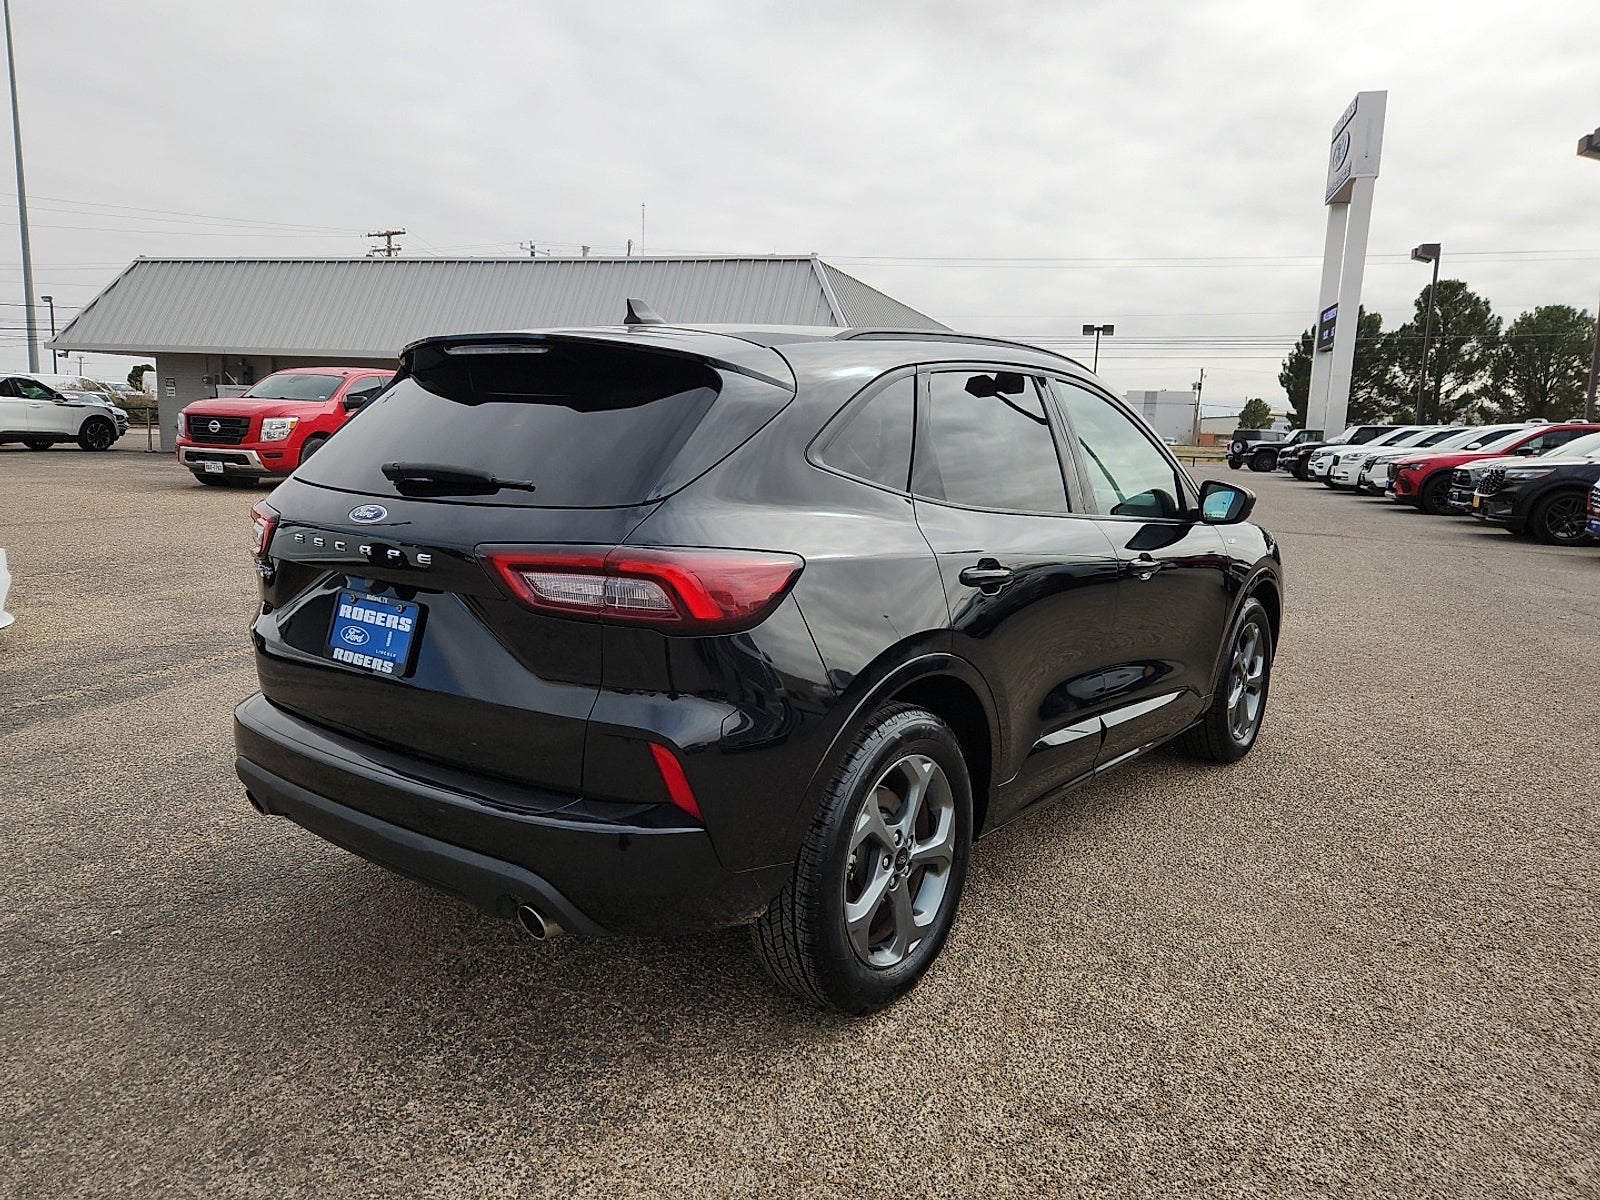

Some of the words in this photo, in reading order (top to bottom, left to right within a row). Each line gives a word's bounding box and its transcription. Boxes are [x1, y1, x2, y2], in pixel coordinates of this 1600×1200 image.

[294, 533, 432, 565] ESCAPE
[339, 604, 412, 633] ROGERS
[345, 627, 365, 643] Ford
[332, 647, 394, 674] ROGERS
